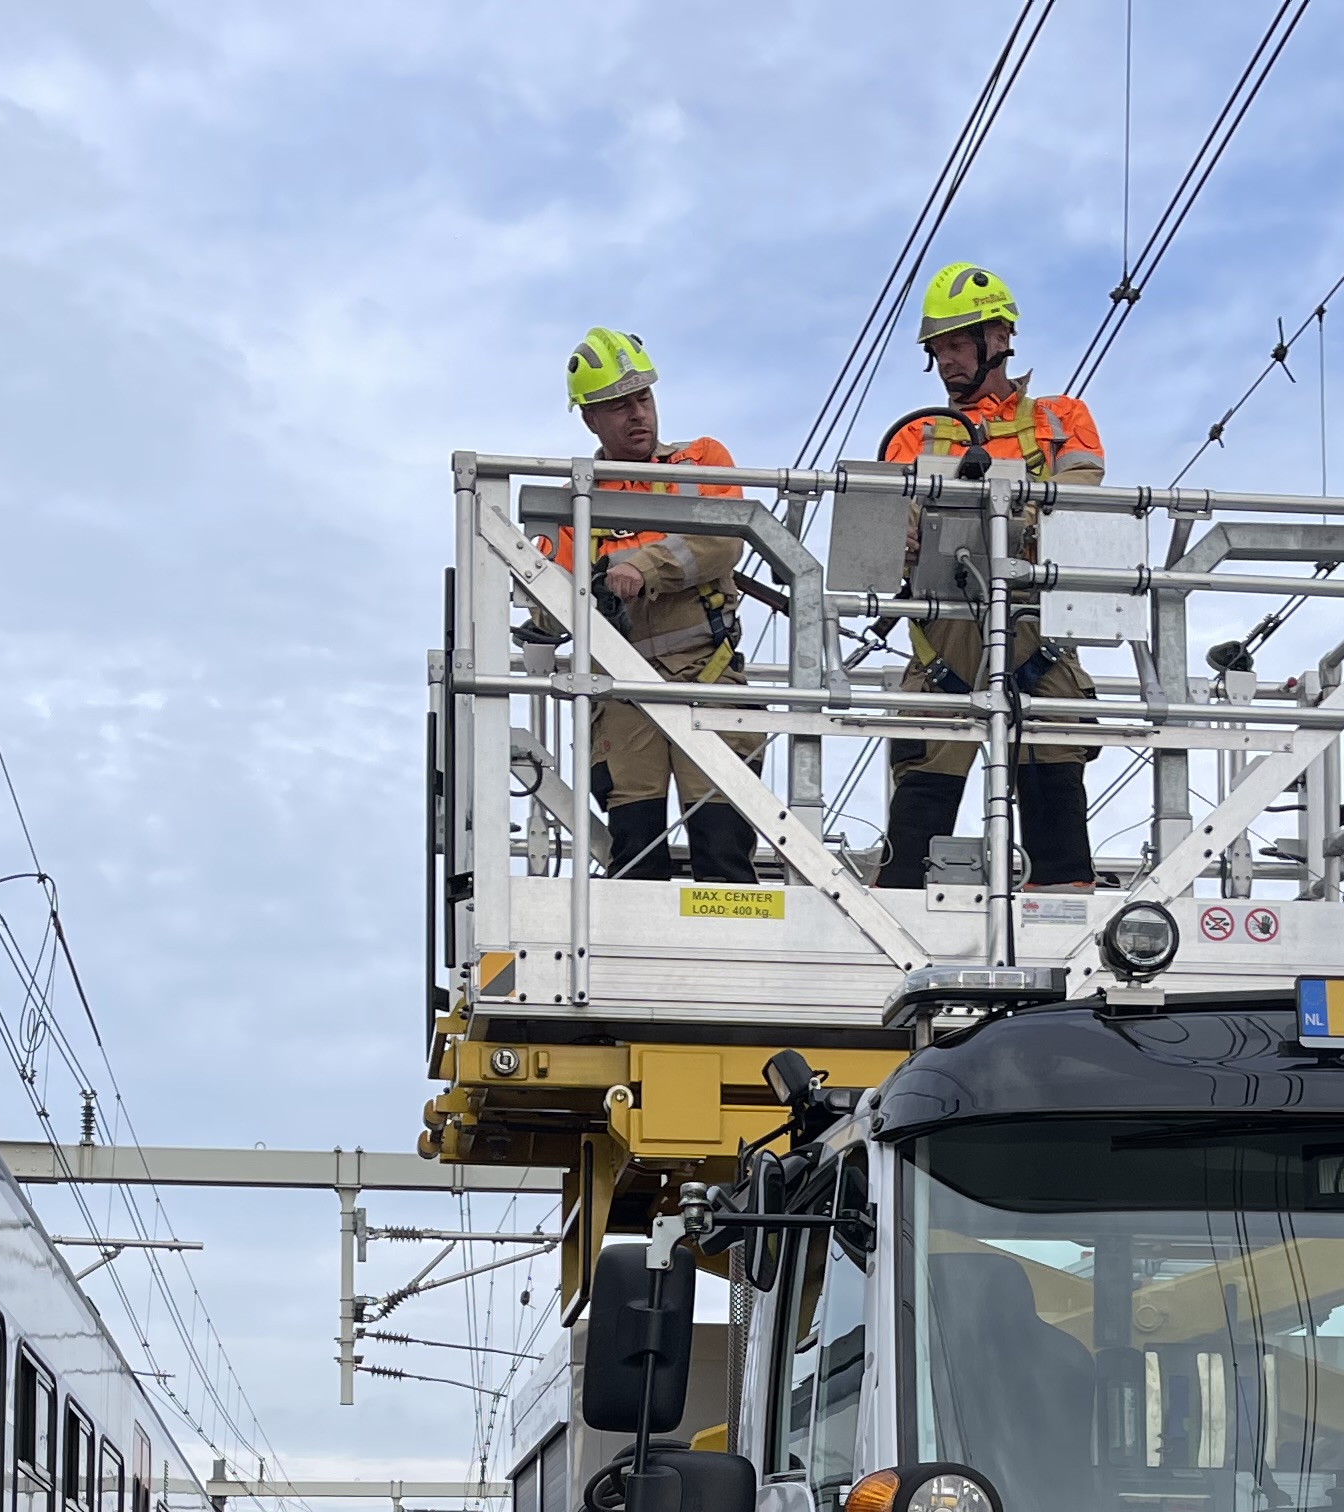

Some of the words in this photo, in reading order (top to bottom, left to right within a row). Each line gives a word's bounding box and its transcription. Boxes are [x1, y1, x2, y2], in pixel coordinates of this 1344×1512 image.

[724, 892, 772, 903] CENTER
[692, 904, 729, 915] LOAD:
[732, 906, 752, 916] 400
[1305, 1013, 1325, 1027] NL
